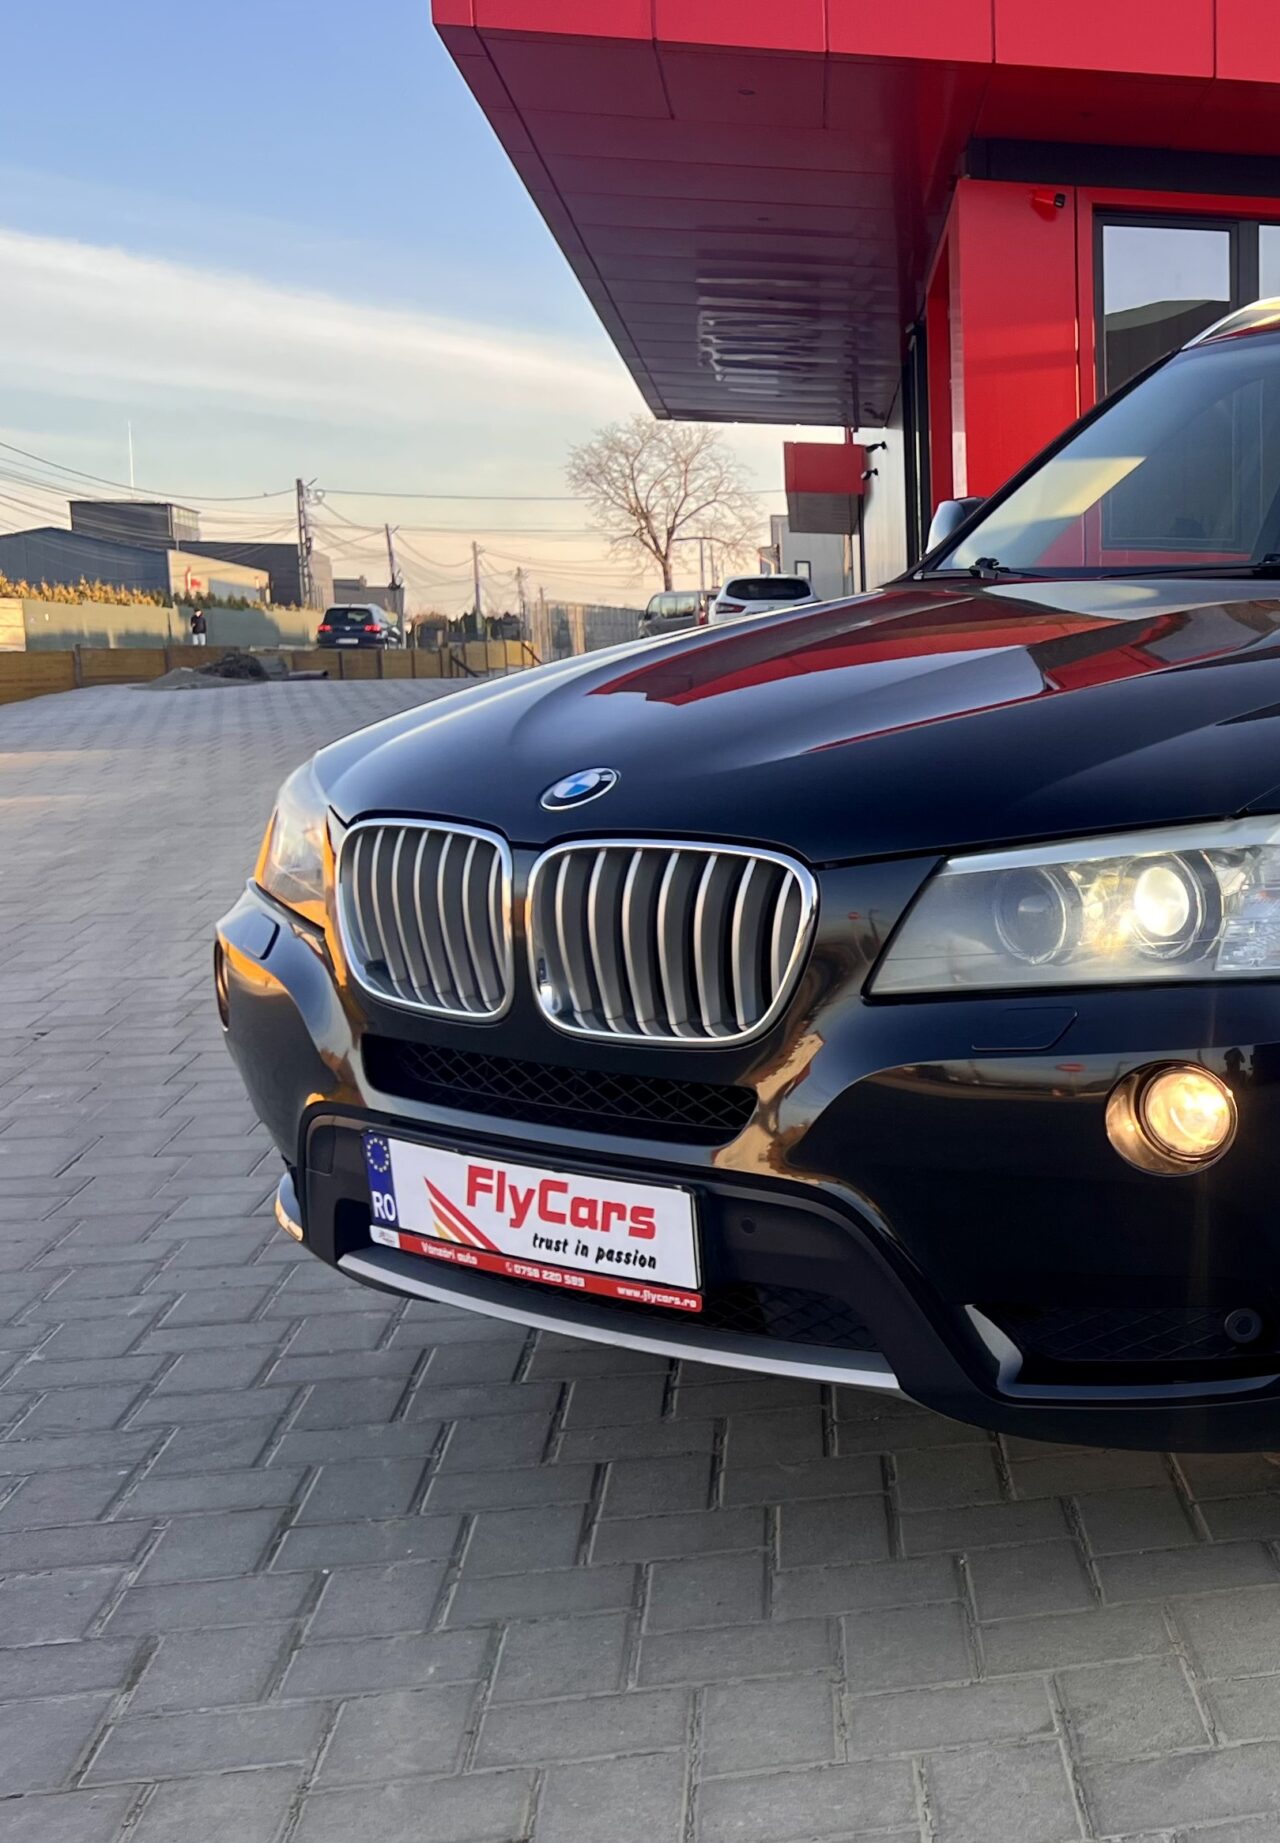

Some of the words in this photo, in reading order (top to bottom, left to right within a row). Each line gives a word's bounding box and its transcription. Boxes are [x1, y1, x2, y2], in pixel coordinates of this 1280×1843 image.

[373, 1191, 396, 1222] RO
[466, 1165, 656, 1240] FlyCars
[457, 1252, 478, 1265] auto
[533, 1233, 569, 1254] trust
[575, 1240, 589, 1257] in
[595, 1248, 657, 1270] passion
[616, 1286, 697, 1308] www.flycars.ro
